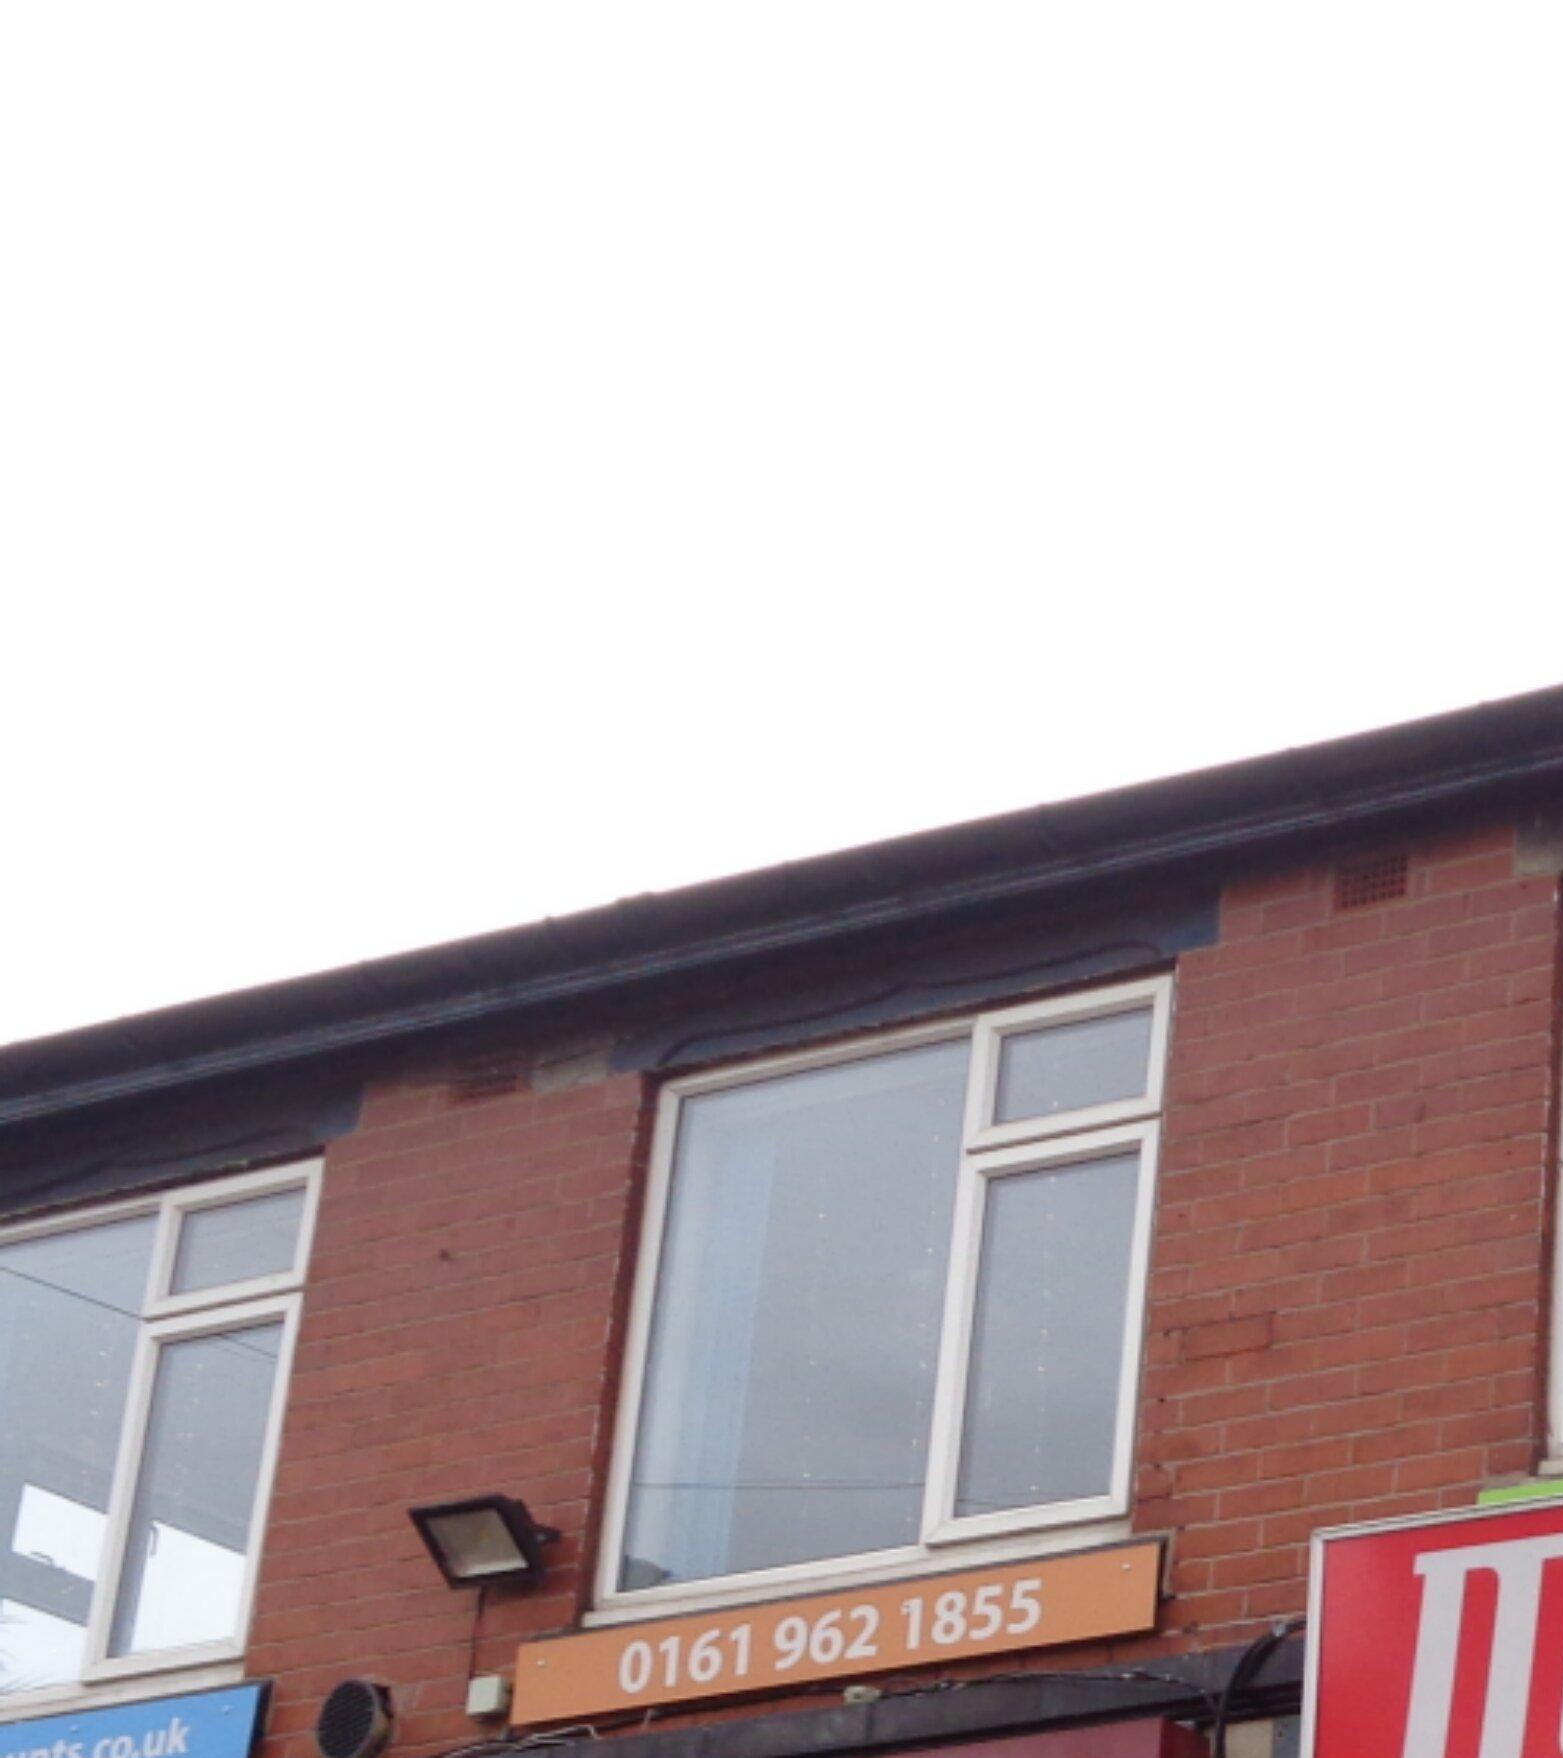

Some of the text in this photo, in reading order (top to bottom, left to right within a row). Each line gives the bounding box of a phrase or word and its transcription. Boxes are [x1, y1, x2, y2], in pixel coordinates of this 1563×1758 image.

[617, 1578, 1043, 1695] 0161 962 1855
